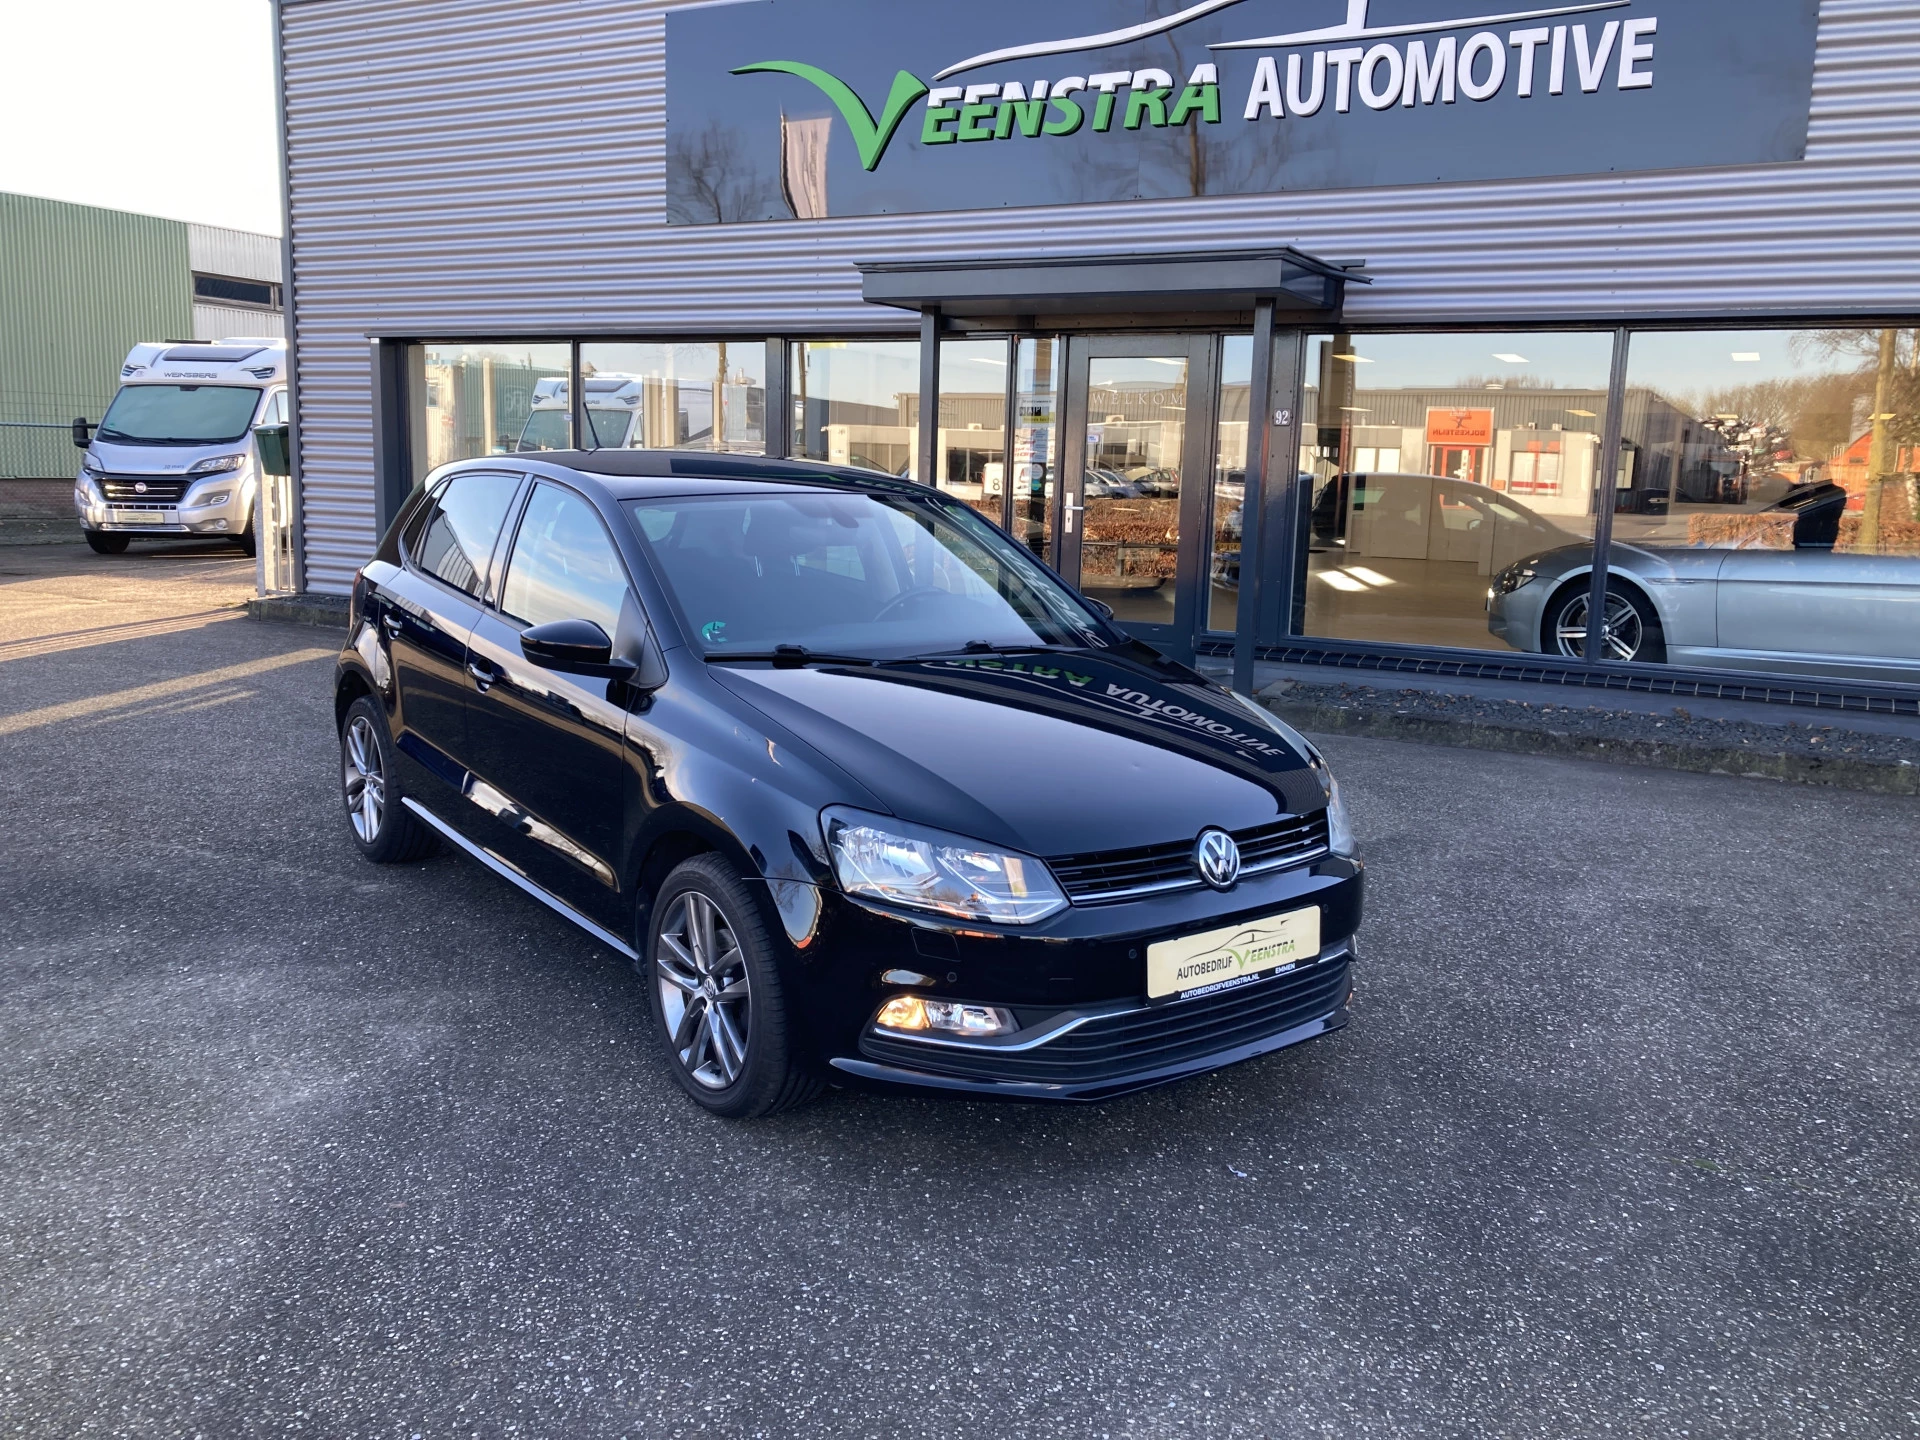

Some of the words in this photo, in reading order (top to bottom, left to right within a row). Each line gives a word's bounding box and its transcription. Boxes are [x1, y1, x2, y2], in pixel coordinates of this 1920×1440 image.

[729, 60, 1220, 172] VEENSTRA
[1243, 16, 1658, 121] AUTOMOTIVE
[1092, 393, 1183, 405] WELKOM
[1275, 410, 1289, 425] 92
[1176, 955, 1233, 981] AUTOBEDRIJF
[1220, 939, 1296, 970] VEENSTRA
[1180, 973, 1260, 1000] AUTOBEDRIJFVEENSTRA.NL
[1274, 962, 1296, 975] EMMEN
